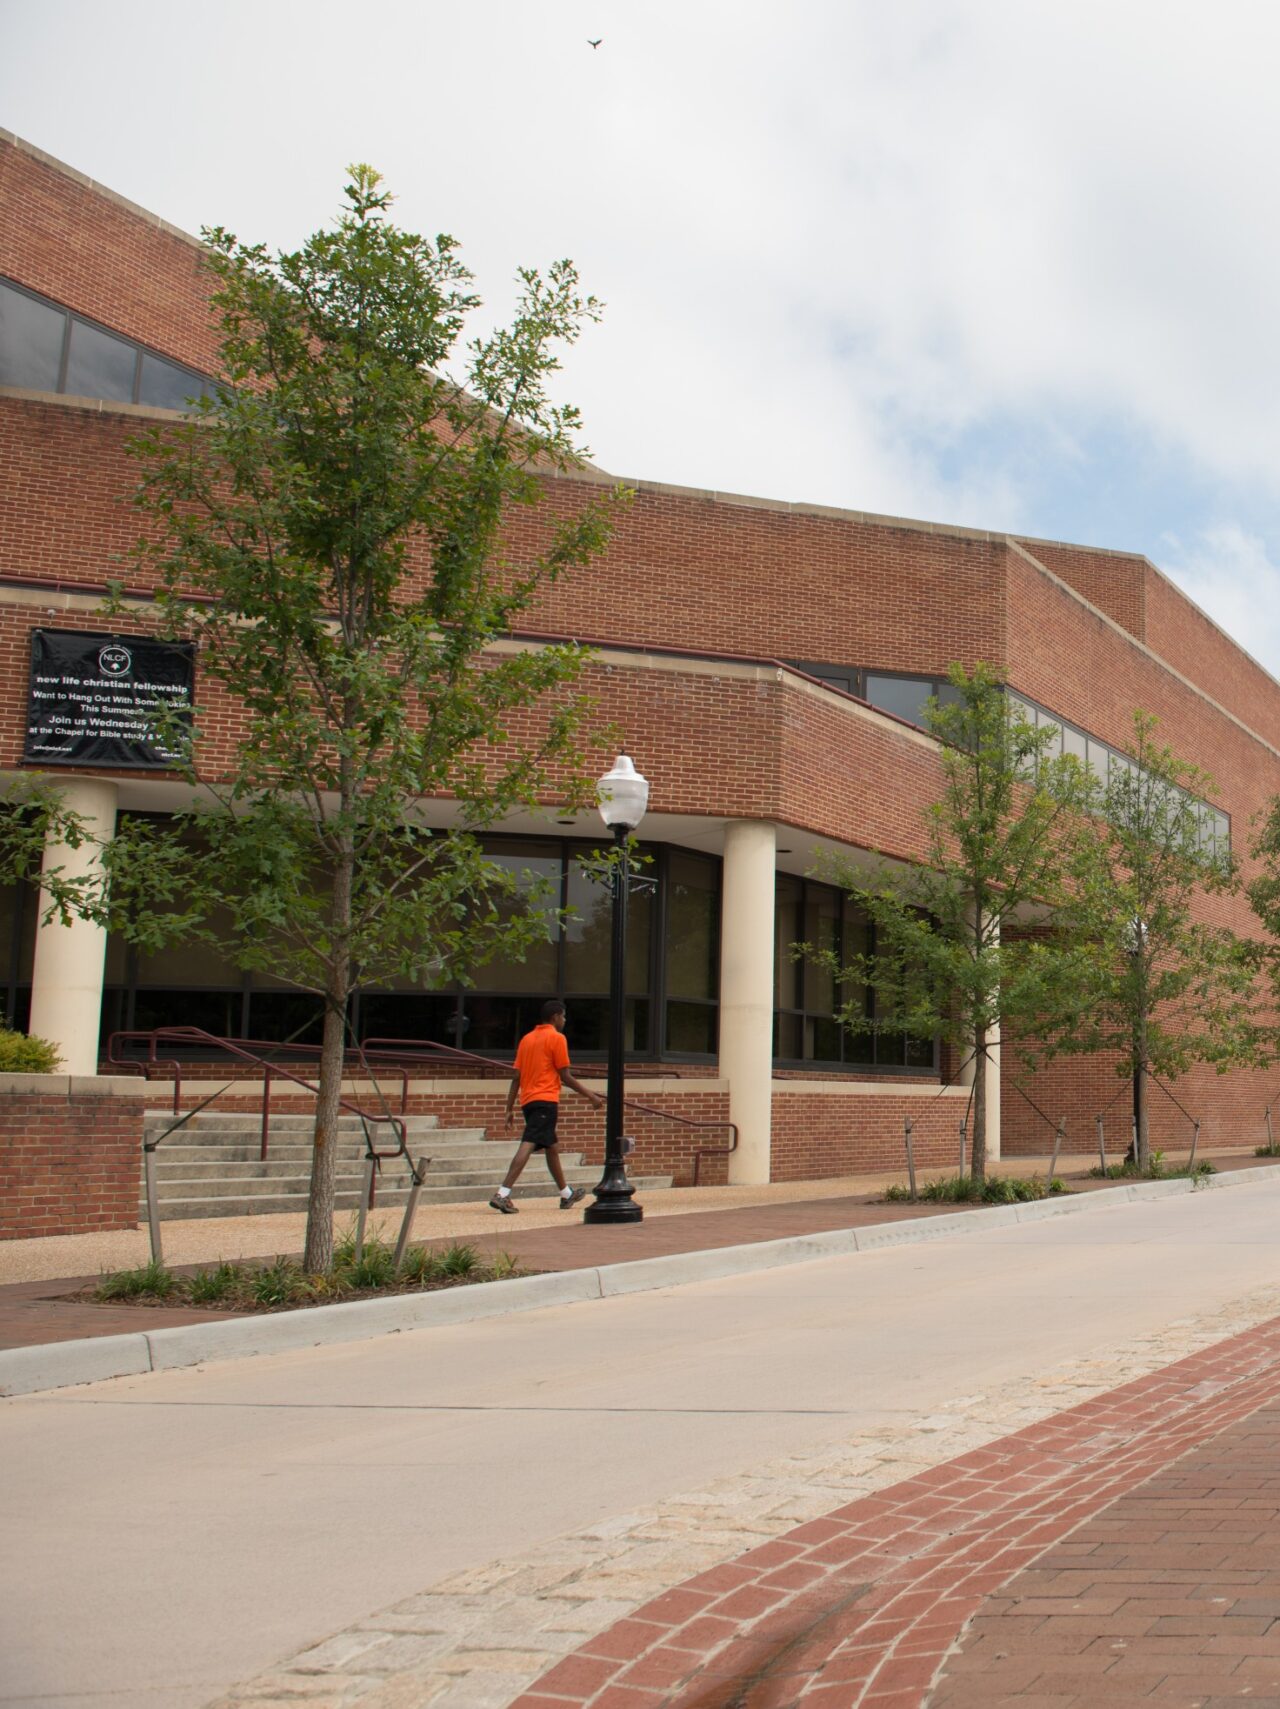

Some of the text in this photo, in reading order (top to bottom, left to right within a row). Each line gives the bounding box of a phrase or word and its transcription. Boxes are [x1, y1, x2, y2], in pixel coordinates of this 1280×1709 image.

[36, 676, 188, 694] new life christian fellowship
[33, 690, 55, 699] Want
[57, 692, 67, 700] to
[68, 693, 92, 703] Hang
[94, 695, 111, 703] Out
[113, 696, 133, 704] With
[135, 697, 159, 706] Some
[80, 704, 99, 713] This
[49, 715, 71, 725] Join
[74, 718, 87, 726] us
[90, 718, 149, 731] Wednesday
[29, 726, 38, 734] at
[55, 727, 84, 737] Chapel
[86, 729, 98, 737] for
[100, 730, 121, 738] Bible
[122, 731, 146, 741] study
